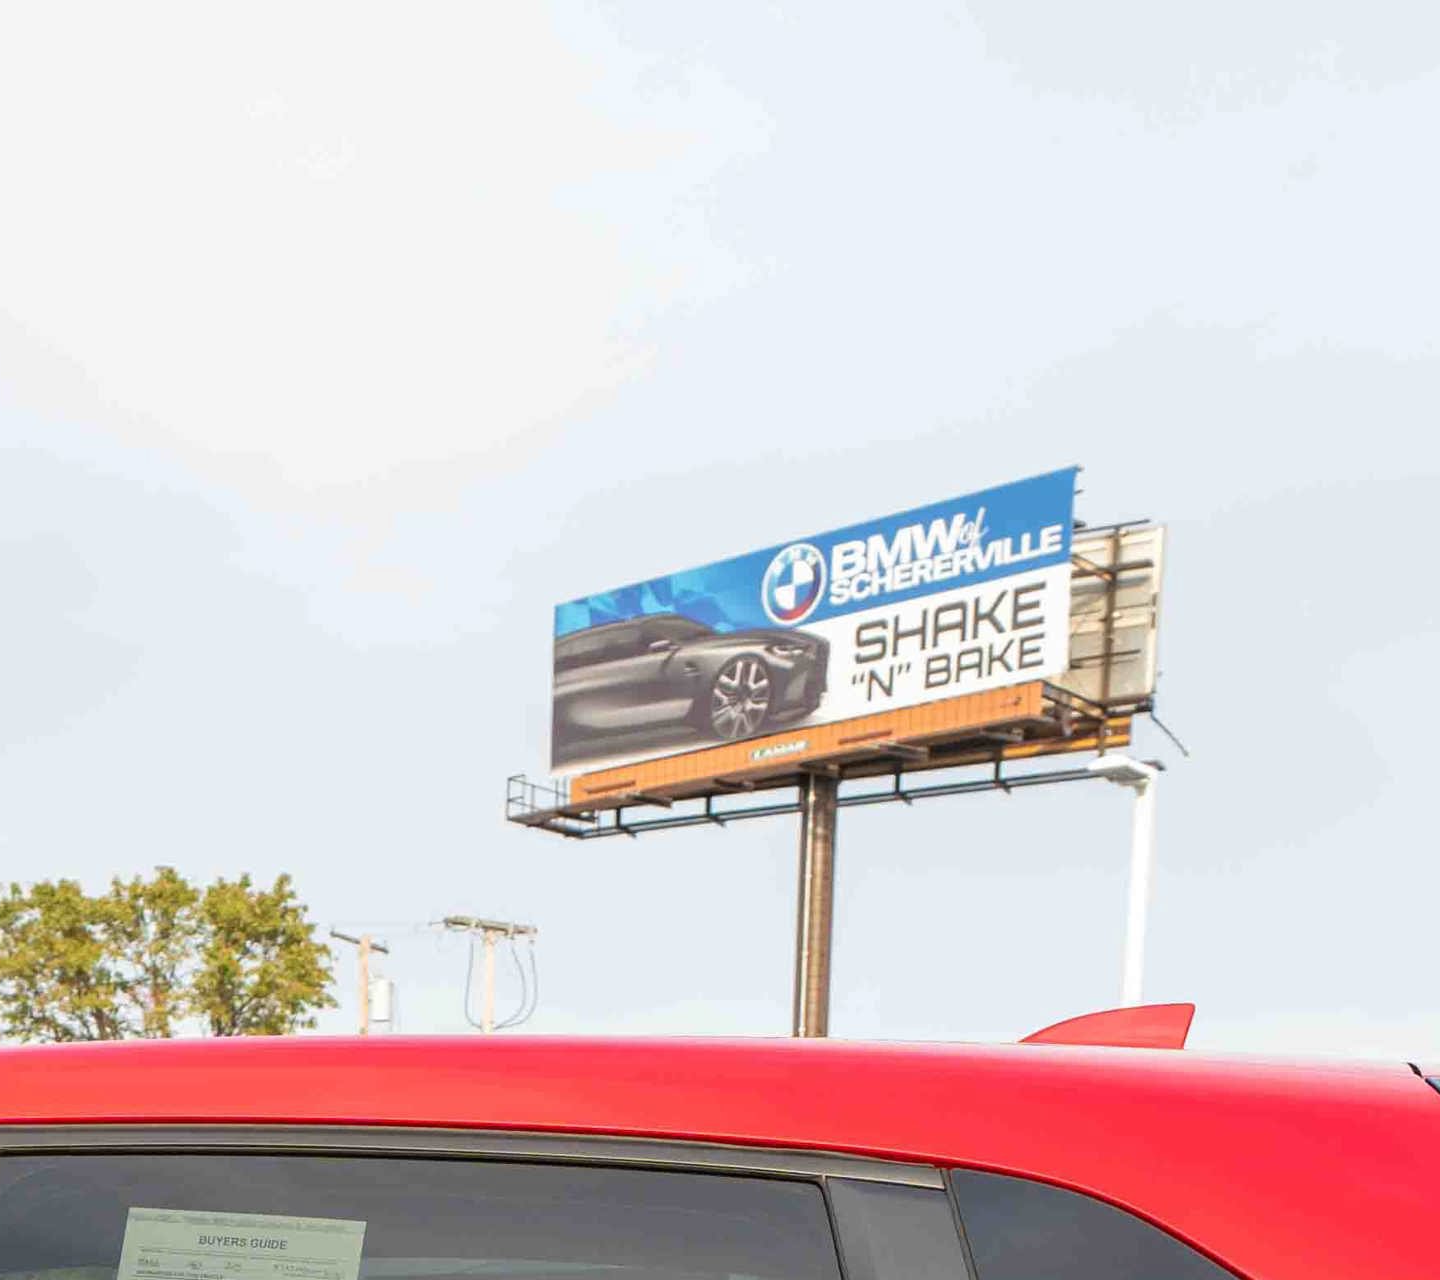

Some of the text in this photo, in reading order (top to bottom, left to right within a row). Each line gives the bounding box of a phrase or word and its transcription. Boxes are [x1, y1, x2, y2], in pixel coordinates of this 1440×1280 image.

[830, 524, 1063, 606] SCHERERVILLE
[831, 513, 966, 576] BMW
[961, 507, 989, 549] of
[855, 581, 1046, 664] SHAKE
[925, 632, 1045, 689] BAKE
[198, 1235, 288, 1250] BUYERS GUIDE
